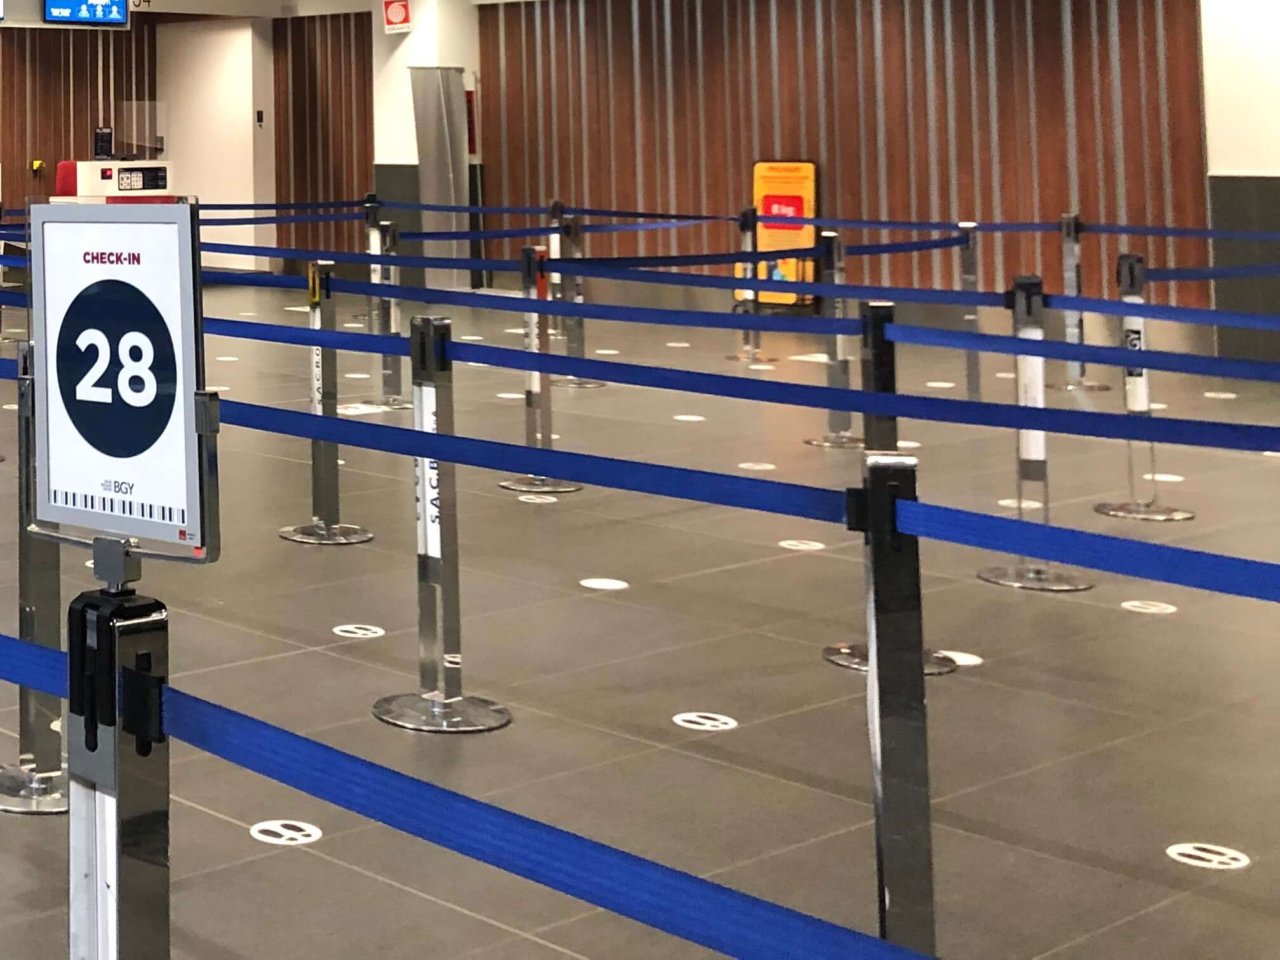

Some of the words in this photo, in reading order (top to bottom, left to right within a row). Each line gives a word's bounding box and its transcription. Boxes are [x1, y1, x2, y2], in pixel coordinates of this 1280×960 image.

[82, 251, 141, 266] CHECK-IN
[75, 328, 158, 408] 28
[113, 480, 135, 495] BGY
